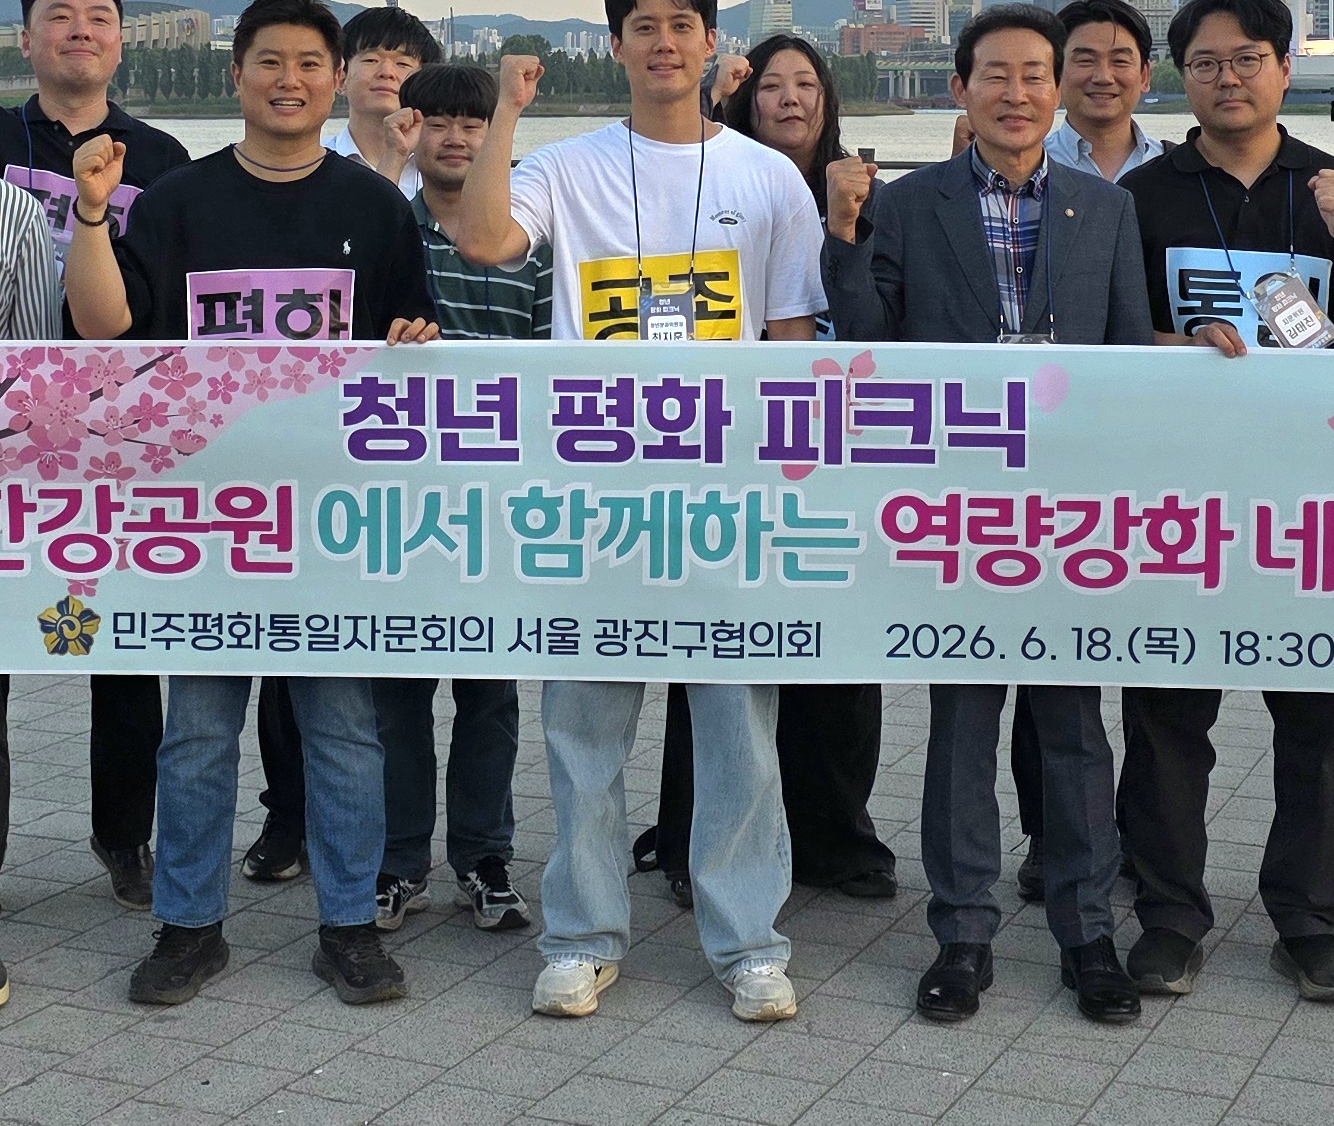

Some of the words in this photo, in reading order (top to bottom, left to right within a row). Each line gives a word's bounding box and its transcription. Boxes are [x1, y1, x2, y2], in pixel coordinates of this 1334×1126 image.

[343, 376, 520, 463] 청년
[551, 378, 731, 464] 평화
[757, 380, 1027, 468] 피크닉
[317, 487, 482, 577] 에서
[507, 486, 860, 581] 함께하는
[880, 493, 1235, 590] 역량강화
[111, 610, 495, 653] 민주평화통일자문회의
[507, 617, 581, 657] 서울
[593, 620, 822, 659] 광진구협의회
[885, 623, 1005, 660] 2026.
[1020, 626, 1056, 660] 6.
[1071, 627, 1196, 665] 18.(목)
[1219, 631, 1334, 667] 18:30
